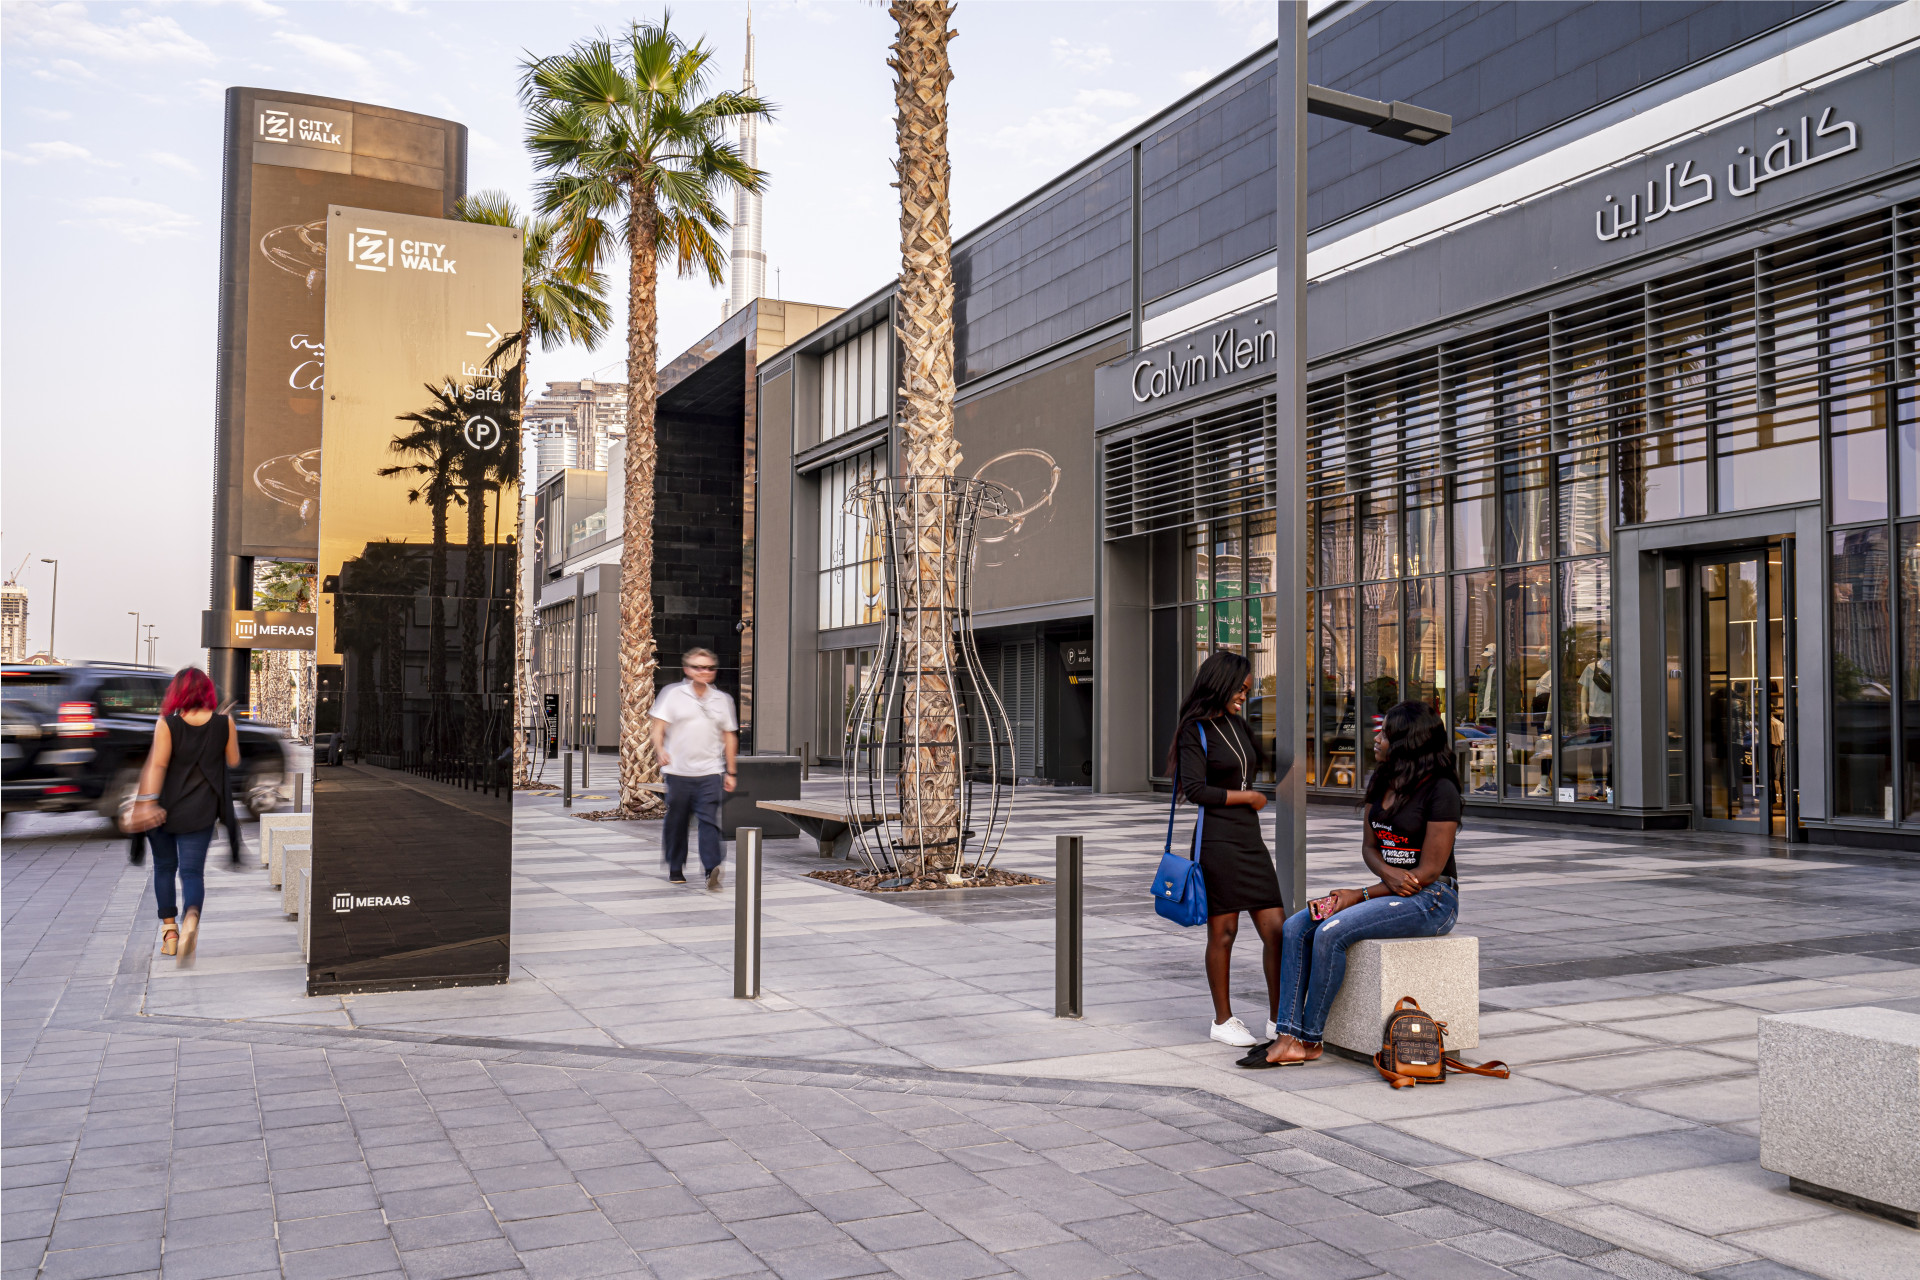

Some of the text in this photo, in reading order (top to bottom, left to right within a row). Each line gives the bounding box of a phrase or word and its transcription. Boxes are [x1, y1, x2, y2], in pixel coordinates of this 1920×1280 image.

[298, 118, 333, 133] CITY
[298, 129, 342, 145] WALK
[1596, 106, 1859, 241] كلفن كلاين
[400, 239, 446, 258] CITY
[400, 254, 457, 274] WALK
[1132, 318, 1277, 402] Calvin Klein
[462, 361, 502, 379] الصفا
[441, 381, 501, 402] Al Safa
[476, 423, 490, 442] P
[259, 624, 315, 636] MERAAS
[355, 895, 411, 908] MERAAS
